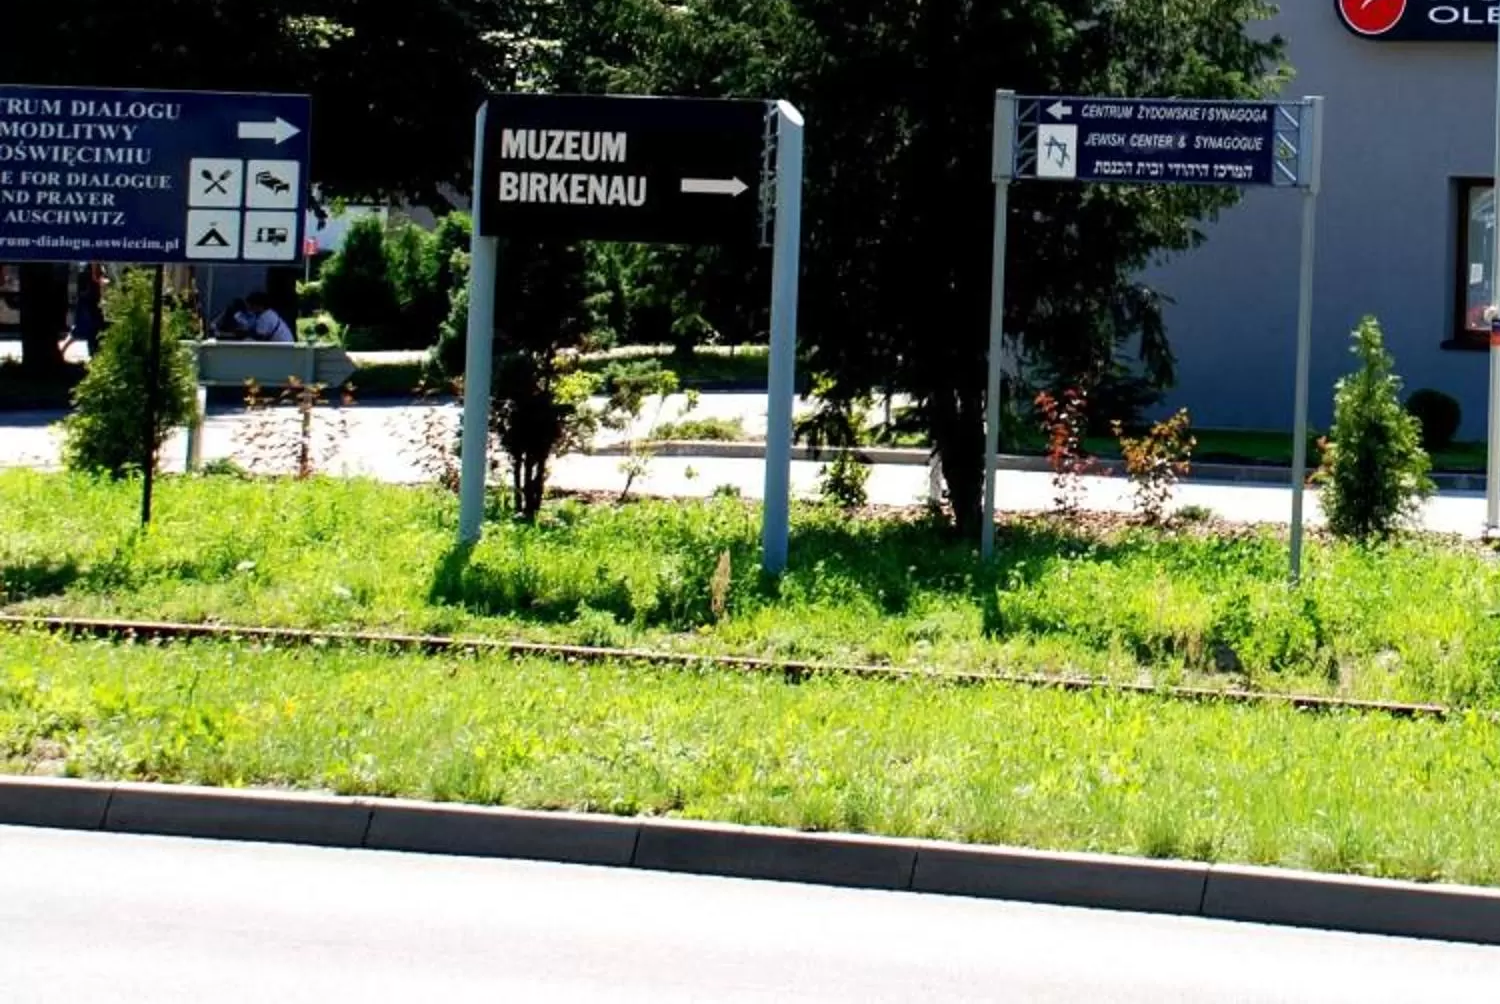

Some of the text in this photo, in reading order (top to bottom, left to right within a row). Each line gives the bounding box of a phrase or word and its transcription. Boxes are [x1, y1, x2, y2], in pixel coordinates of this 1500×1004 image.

[0, 98, 181, 119] RUM DIALOGU
[1081, 104, 1133, 119] CENTRUM
[1207, 107, 1268, 122] SYNAGOGA
[0, 121, 138, 141] MODLITWY
[501, 128, 627, 163] MUZEUM
[1084, 132, 1263, 151] JEWISH CENTER & SYNAGOGUE
[21, 171, 60, 186] FOR
[67, 172, 172, 189] DIALOGUE
[499, 170, 647, 207] BIRKENAU
[36, 191, 115, 207] PRAYER
[4, 209, 125, 226] AUSCHWITZ
